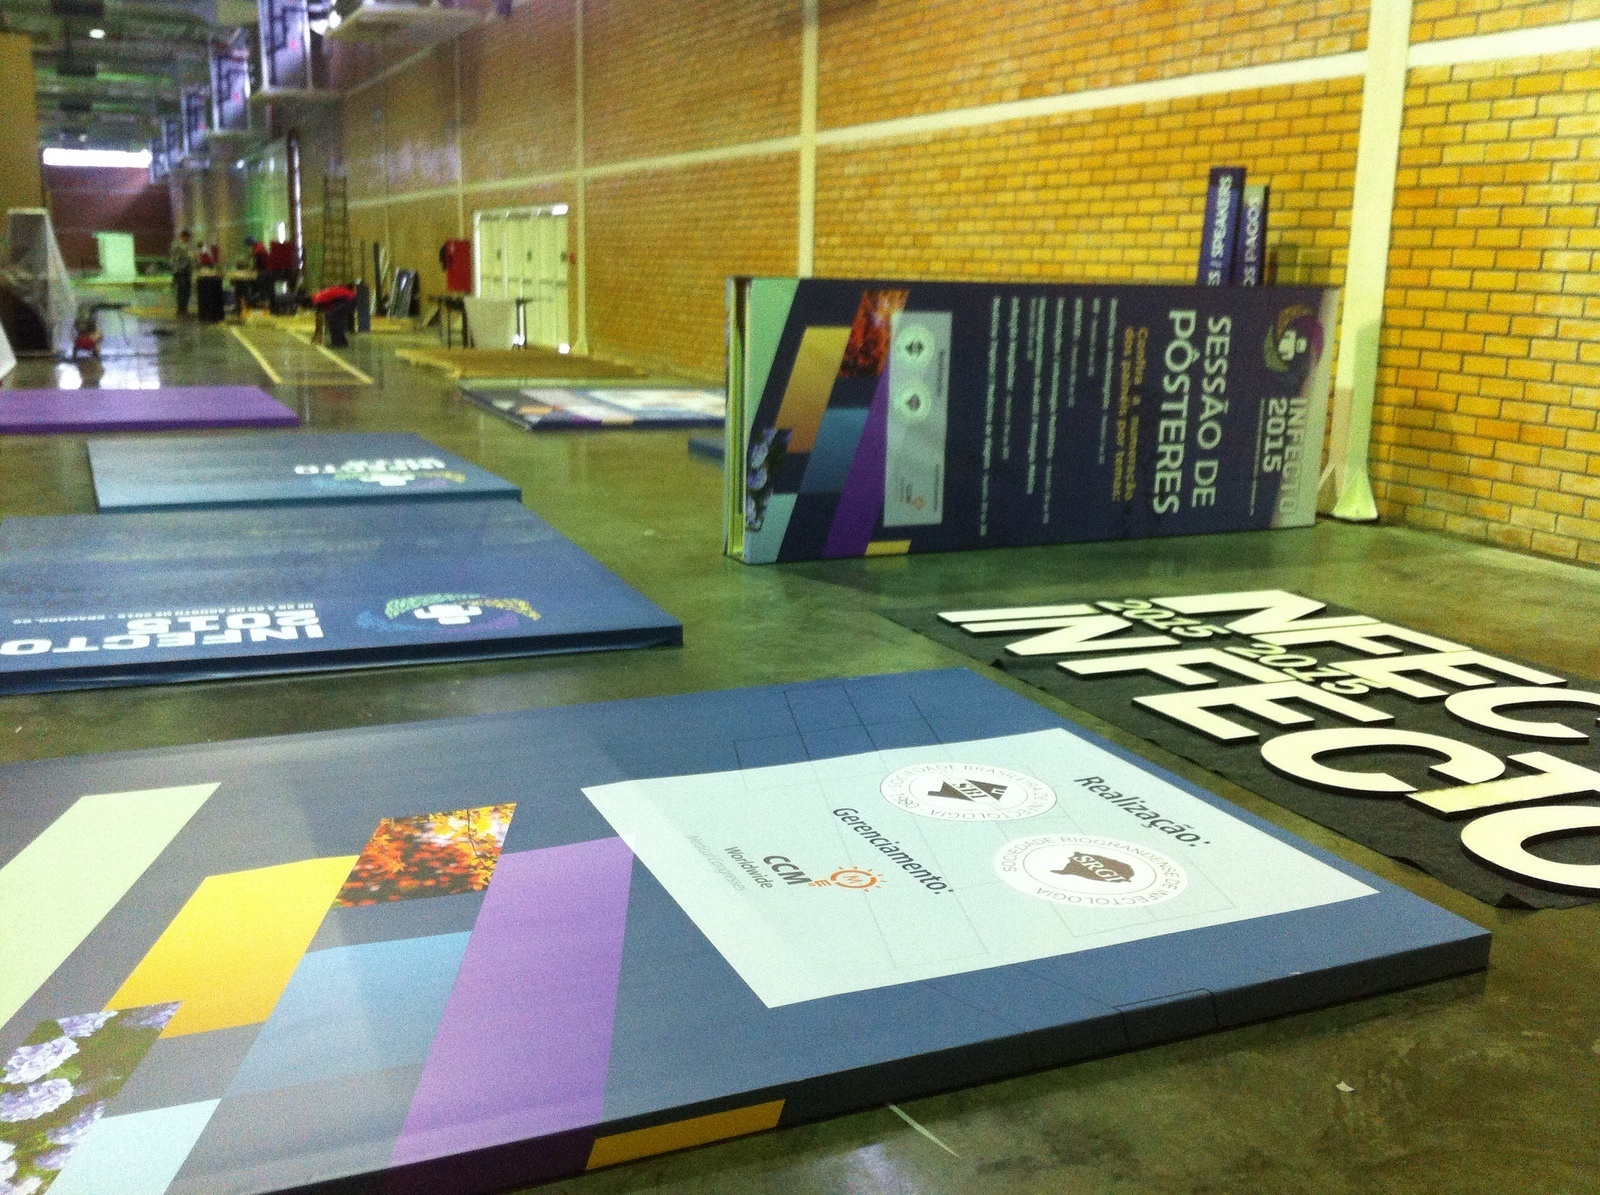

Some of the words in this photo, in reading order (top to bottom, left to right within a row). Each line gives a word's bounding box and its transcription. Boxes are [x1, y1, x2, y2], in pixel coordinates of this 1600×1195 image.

[1123, 326, 1135, 357] dos
[1133, 327, 1149, 385] Confira
[1197, 315, 1232, 450] SESSÃO
[1153, 309, 1200, 514] PÔSTERES
[1262, 397, 1289, 473] 2015
[1278, 397, 1308, 515] INFECTO
[1124, 415, 1140, 500] numeração
[1191, 459, 1219, 508] DE
[0, 624, 324, 655] INFECTO
[127, 610, 320, 634] 2015
[1095, 599, 1232, 637] 2015
[1224, 642, 1391, 695] 2015
[953, 782, 990, 799] SBI
[1073, 776, 1211, 847] Realização:
[724, 846, 774, 889] Worldwide
[763, 855, 813, 885] CCM
[832, 807, 954, 895] Gerenciamento:
[1001, 837, 1055, 873] SOCIEDADE
[1060, 836, 1176, 877] RIOGRANDENSE
[1072, 854, 1127, 883] SRGI
[1036, 887, 1168, 906] INFECTOLOGIA
